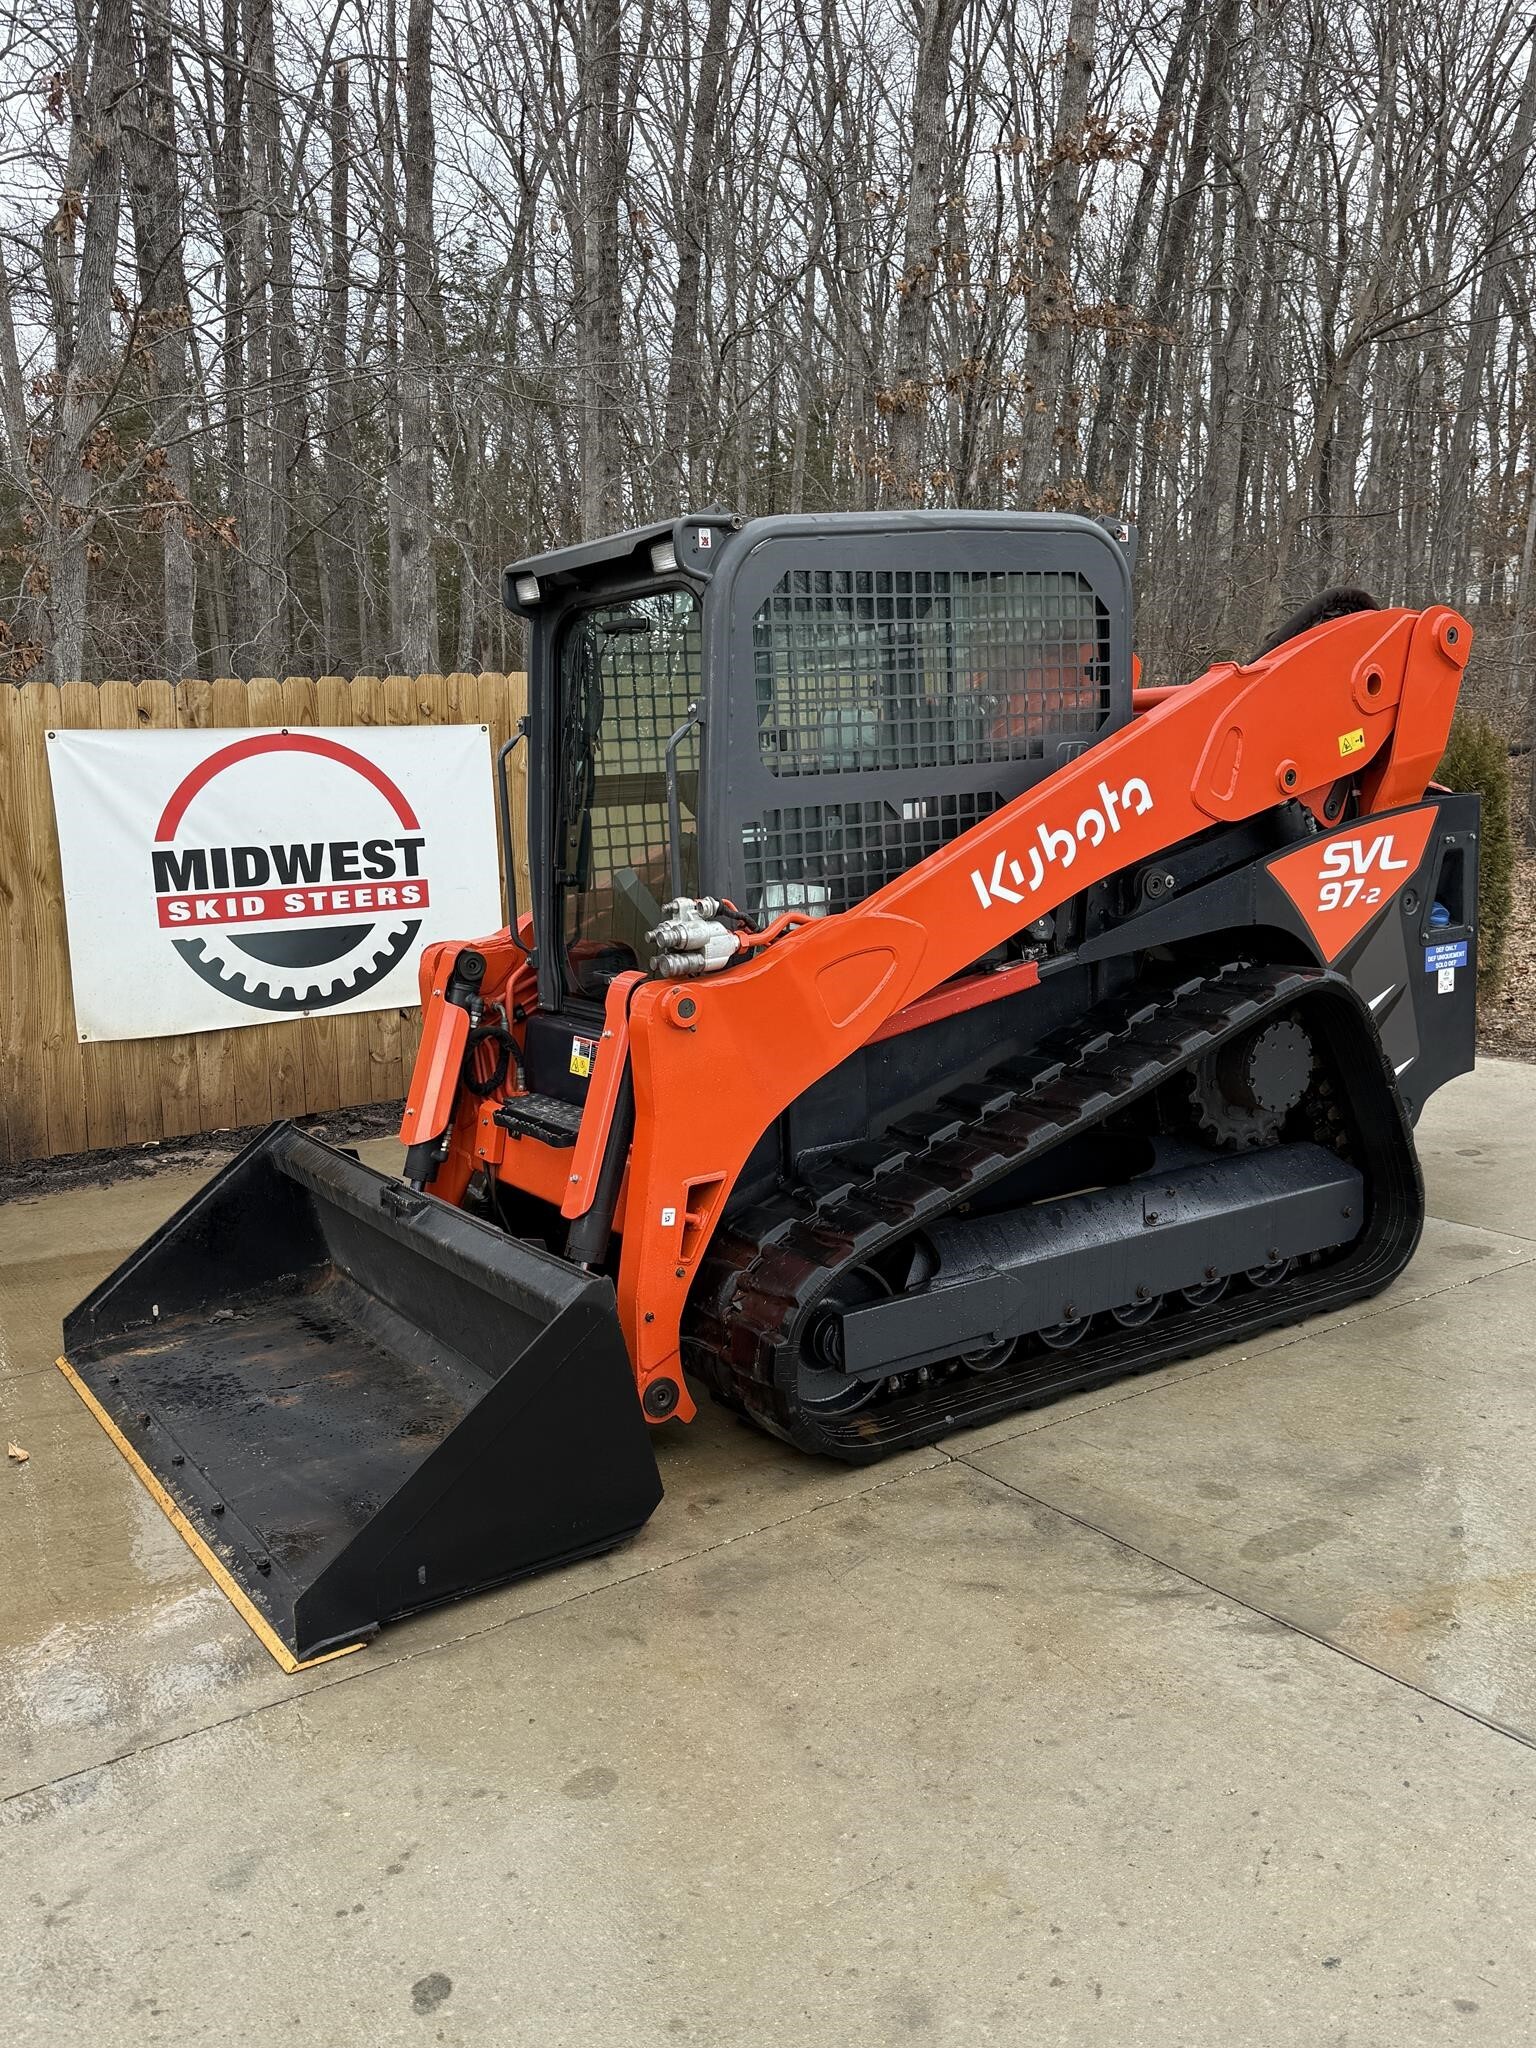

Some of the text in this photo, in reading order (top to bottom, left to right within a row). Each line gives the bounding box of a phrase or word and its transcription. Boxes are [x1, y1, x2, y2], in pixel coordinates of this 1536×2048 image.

[151, 837, 426, 893] MIDWEST
[970, 777, 1154, 910] Kubota
[1318, 835, 1408, 879] SVL
[167, 885, 421, 922] SKID STEERS
[1317, 878, 1381, 912] 97-2
